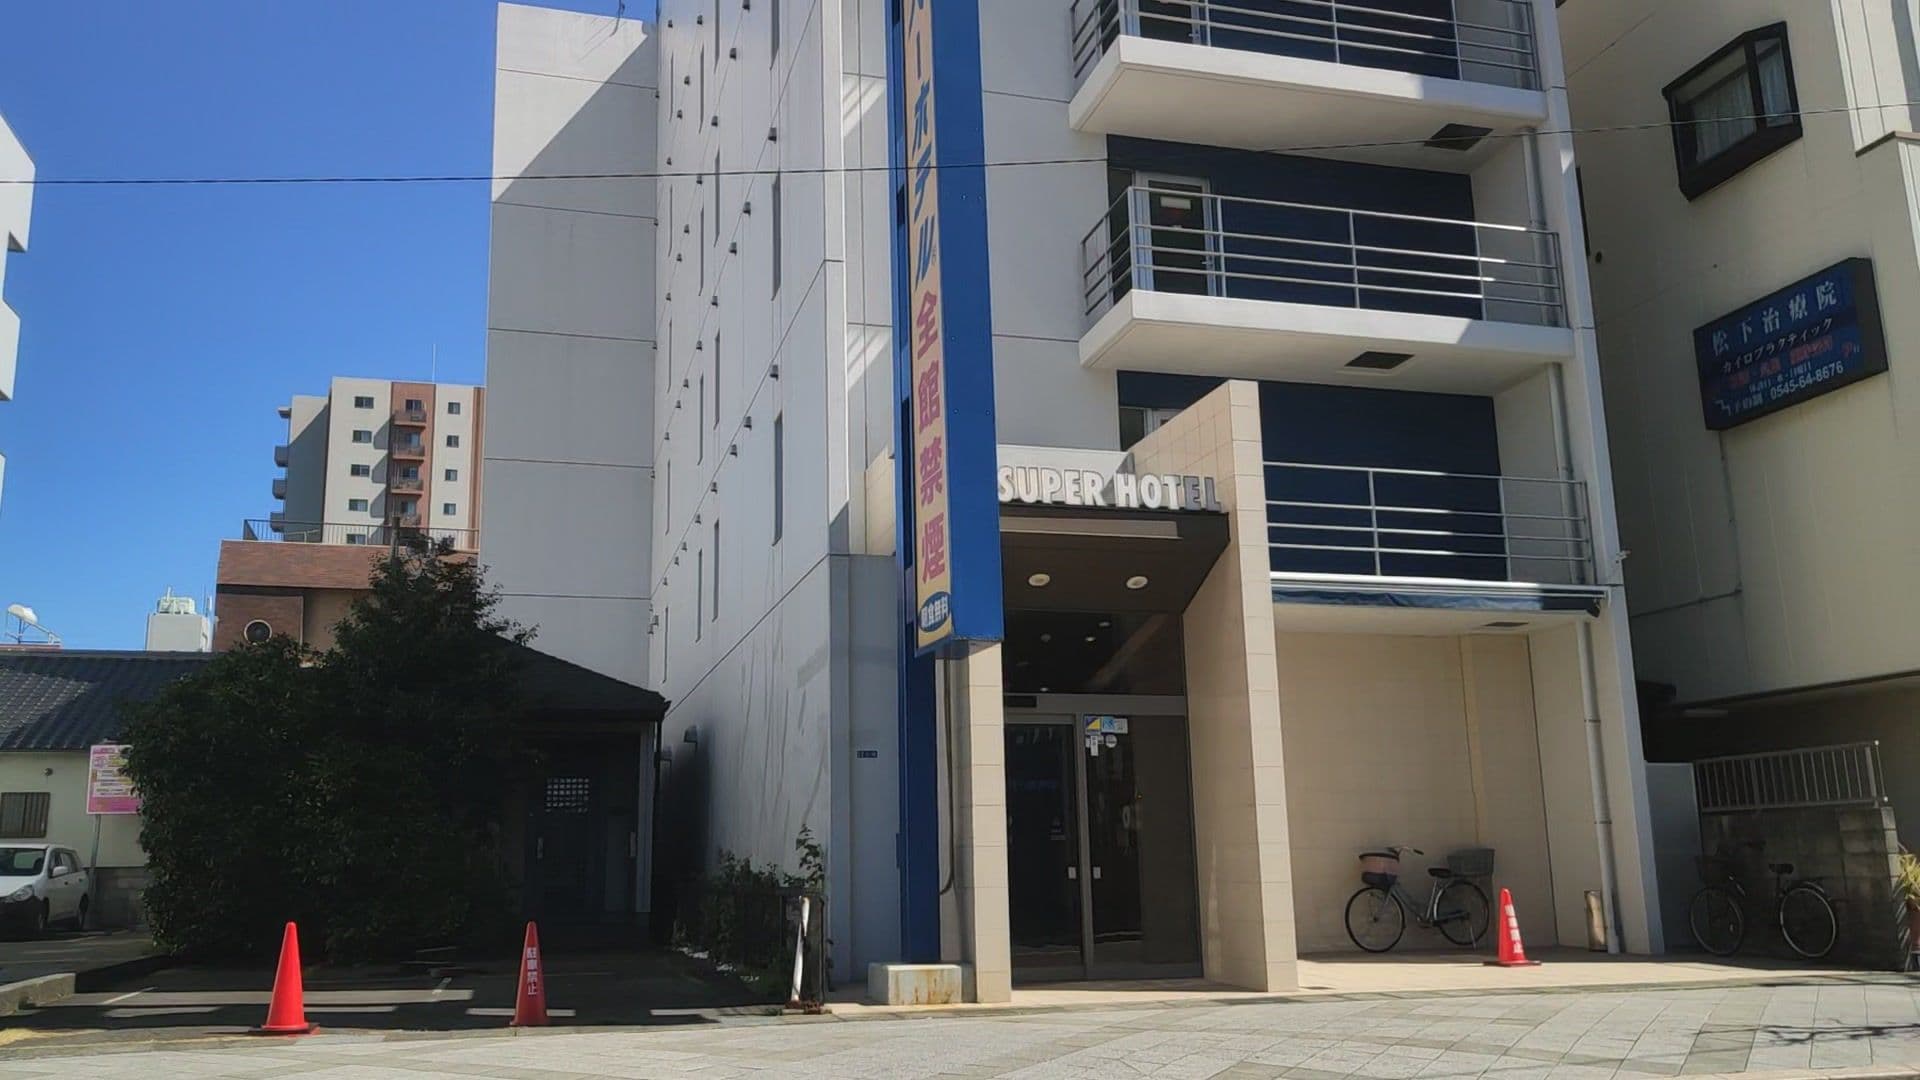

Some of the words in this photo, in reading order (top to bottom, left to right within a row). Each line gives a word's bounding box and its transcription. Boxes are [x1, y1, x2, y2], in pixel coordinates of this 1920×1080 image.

[908, 0, 935, 291] ーホテル
[1712, 281, 1837, 356] 松下治療院
[1770, 361, 1844, 400] 0545-64-8676
[916, 291, 945, 584] 全館禁煙
[998, 466, 1105, 507] SUPER
[1114, 472, 1221, 512] HOTEL
